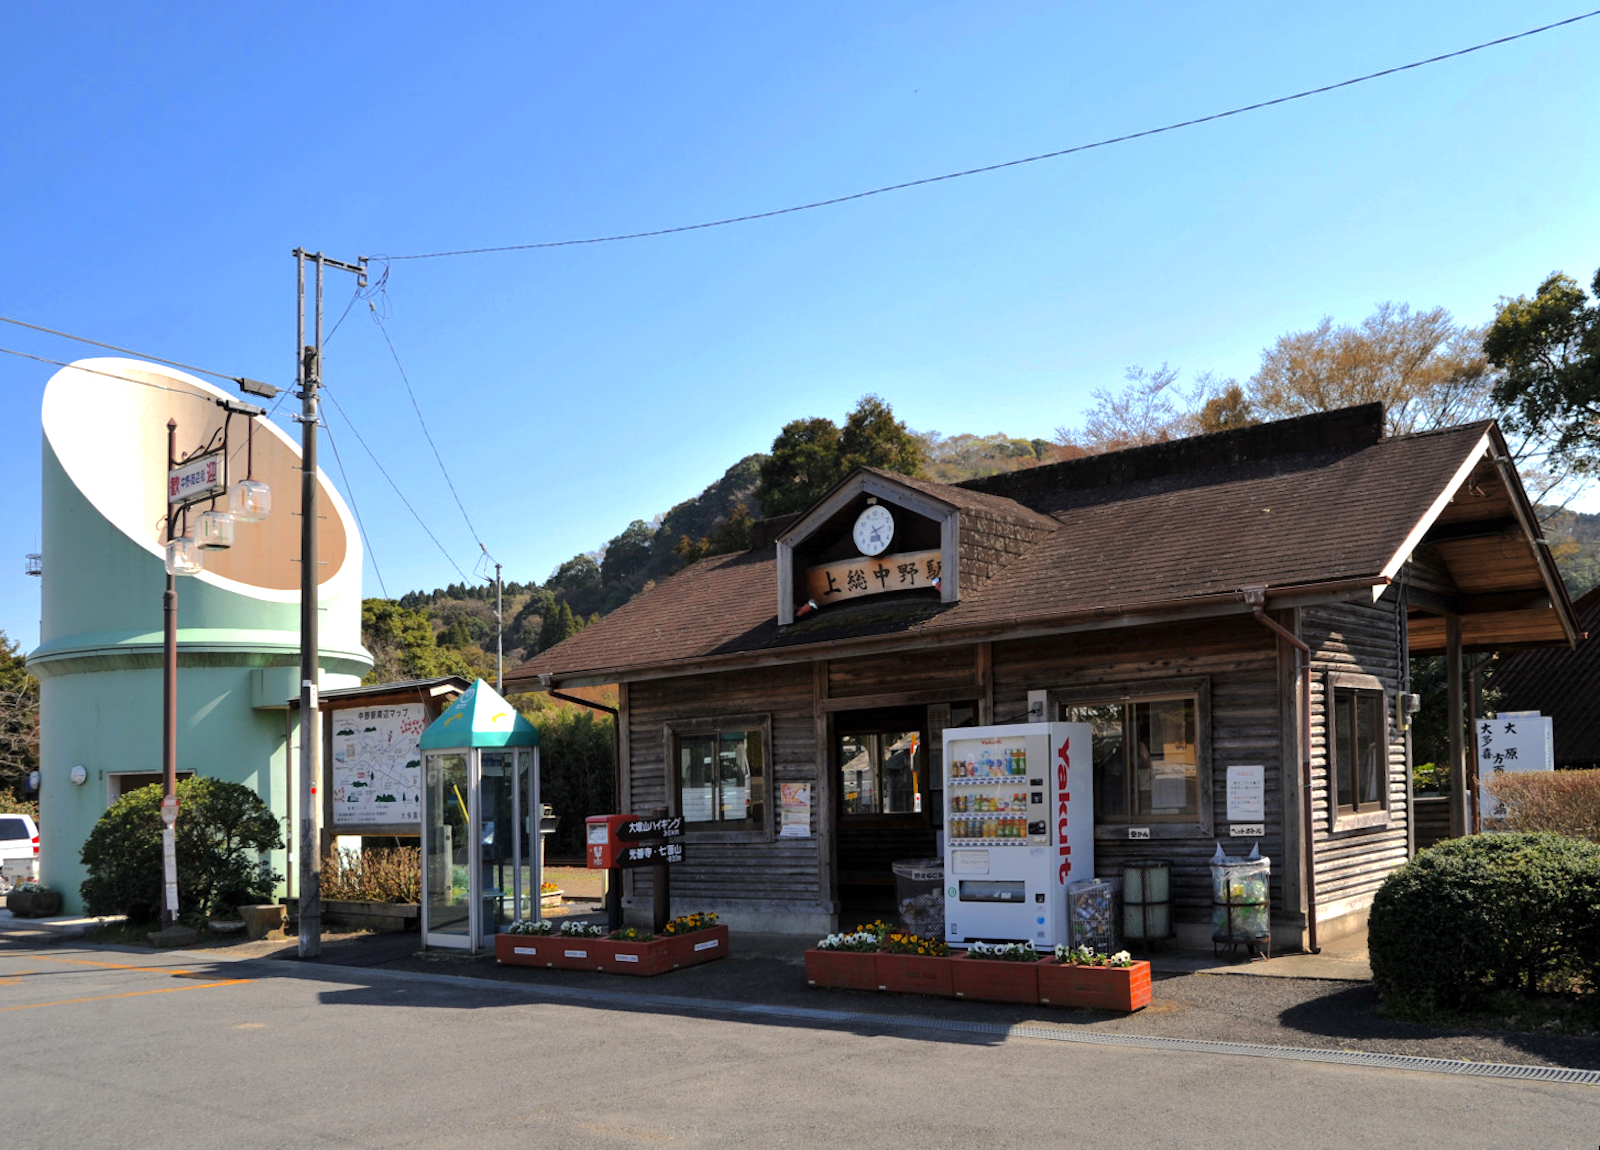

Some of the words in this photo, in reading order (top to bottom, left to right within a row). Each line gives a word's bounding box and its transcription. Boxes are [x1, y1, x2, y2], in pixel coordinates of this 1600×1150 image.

[823, 559, 942, 595] 上総中野駅
[358, 708, 409, 720] 中野駅周辺マップ
[1481, 723, 1493, 760] 大多喜
[1504, 722, 1518, 760] 大原
[401, 811, 420, 820] 大多喜
[1057, 736, 1072, 886] Yakult
